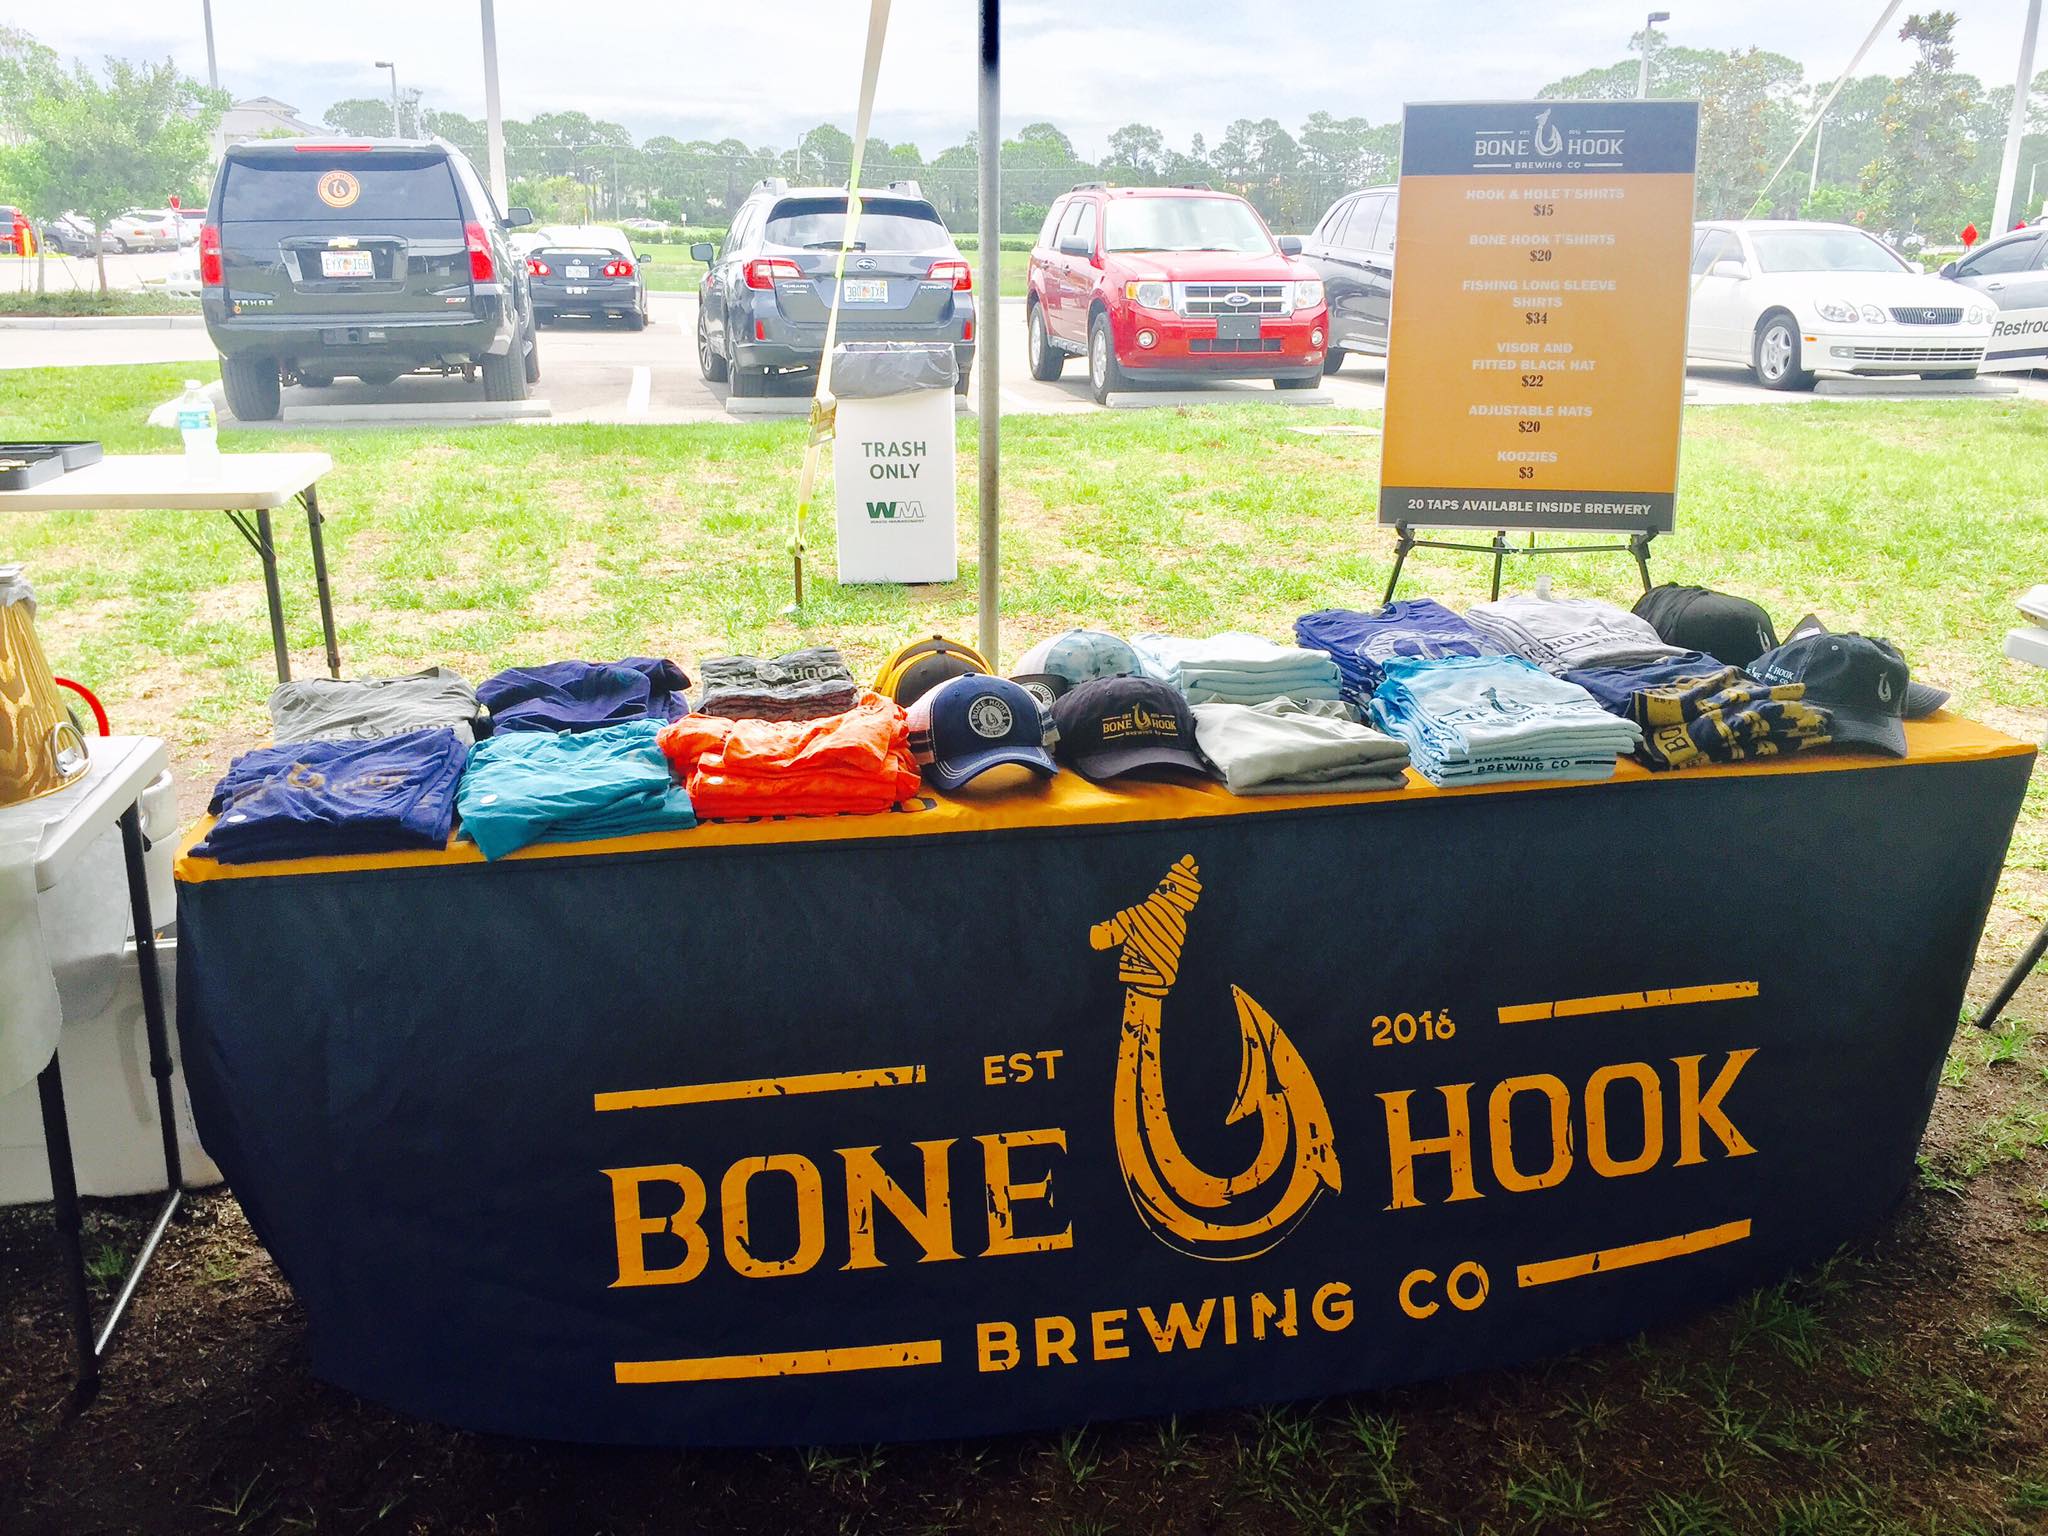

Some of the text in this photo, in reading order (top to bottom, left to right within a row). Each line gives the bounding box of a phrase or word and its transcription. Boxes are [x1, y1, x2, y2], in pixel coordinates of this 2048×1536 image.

[1475, 138, 1625, 157] BONE HOOK
[1515, 161, 1581, 170] BREWING CO
[1466, 190, 1504, 200] HOOK
[1509, 190, 1520, 200] &
[1523, 189, 1561, 200] HOLE
[1533, 204, 1554, 217] $15
[1469, 234, 1507, 246] BONE
[1511, 234, 1550, 246] HOOK
[1529, 250, 1552, 262] $20
[1463, 280, 1617, 291] FISHING LONG SLEEVE
[1512, 297, 1563, 308] SHIRTS
[1526, 312, 1548, 325] $34
[1497, 343, 1573, 353] VISOR AND
[1472, 359, 1596, 371] FITTED BLACK HAT
[1521, 375, 1543, 387] $22
[1469, 405, 1592, 417] ADJUSTABLE HATS
[1518, 421, 1541, 433] $20
[861, 441, 926, 458] TRASH
[1497, 452, 1558, 462] KOOZIES
[869, 463, 920, 480] ONLY
[1519, 467, 1534, 479] $3
[866, 501, 924, 518] WM
[1408, 498, 1651, 515] 20 TAPS AVAILABLE INSIDE BREWERY
[791, 665, 844, 682] HOOK
[1773, 666, 1795, 680] HOOK
[971, 699, 1010, 720] BONE HOOK
[1103, 719, 1177, 734] BONE HOOK
[1551, 760, 1570, 769] CO
[983, 1008, 1456, 1085] EST 2016
[599, 1047, 1760, 1288] BONE HOOK
[977, 1261, 1490, 1372] BREWING CO
